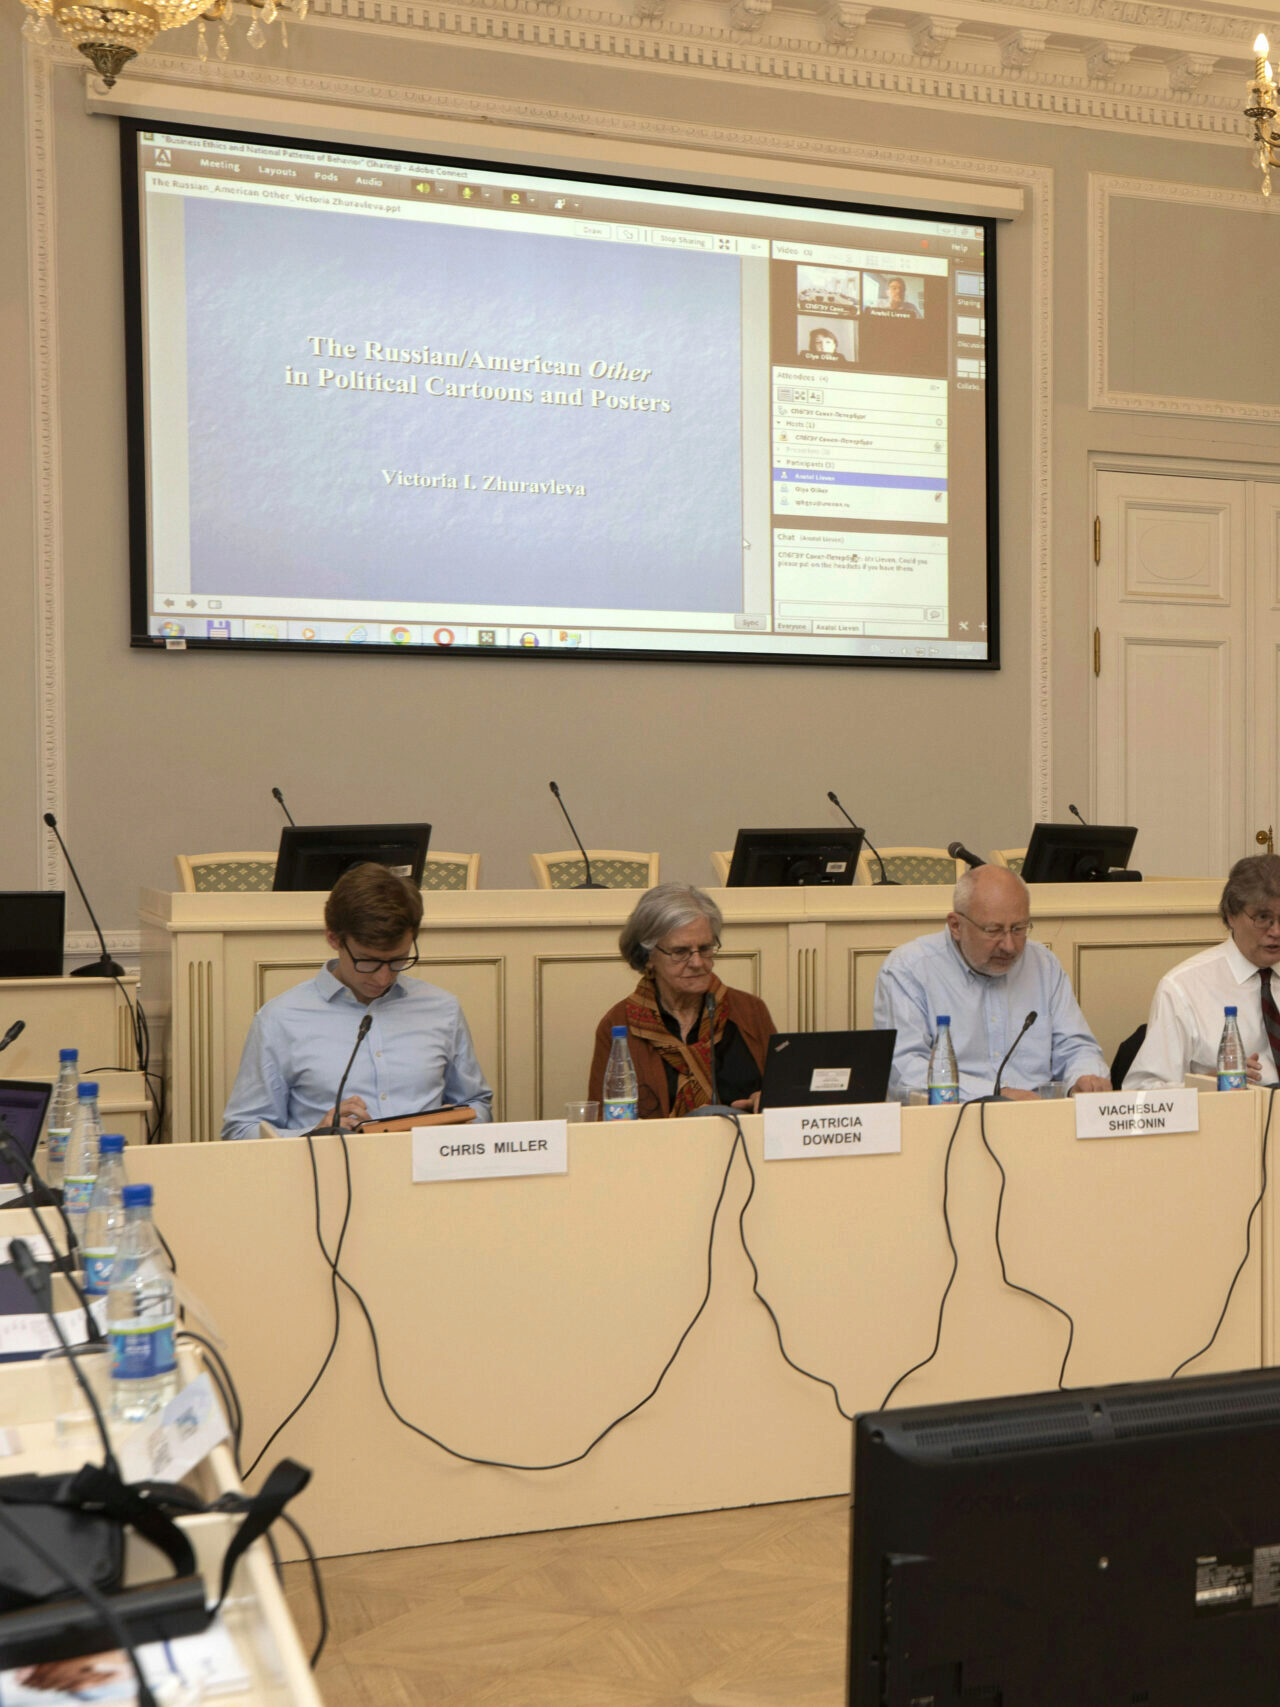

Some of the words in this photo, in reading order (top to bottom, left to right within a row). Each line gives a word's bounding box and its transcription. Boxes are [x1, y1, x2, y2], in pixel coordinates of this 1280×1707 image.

[202, 140, 227, 150] Ethics
[229, 143, 245, 153] and
[247, 146, 280, 157] National
[282, 150, 315, 161] Patterns
[408, 164, 434, 174] Adobe
[436, 167, 468, 178] Connect
[199, 158, 241, 173] Meeting
[258, 165, 297, 177] Layouts
[314, 171, 339, 182] Pods
[355, 176, 384, 187] Audio
[152, 177, 169, 188] The
[660, 234, 676, 244] Stop
[678, 236, 705, 248] Sharing
[952, 243, 968, 253] Help
[776, 245, 799, 255] Video
[957, 299, 981, 309] Sharing
[306, 334, 357, 360] The
[363, 340, 582, 378] Russian/American
[588, 359, 653, 383] Other
[777, 371, 815, 381] Attendees
[284, 366, 309, 387] in
[317, 367, 418, 395] Political
[425, 376, 534, 403] Cartoons
[540, 387, 583, 407] and
[591, 390, 672, 414] Posters
[381, 469, 459, 490] Victoria
[463, 474, 477, 490] I.
[482, 475, 587, 497] Zhuravleva
[777, 533, 795, 541] Chat
[1098, 1101, 1175, 1117] VIACHESLAV
[801, 1115, 864, 1130] PATRICIA
[1108, 1117, 1166, 1132] SHIRONIN
[802, 1131, 863, 1147] DOWDEN
[439, 1142, 487, 1158] CHRIS
[493, 1138, 549, 1155] MILLER
